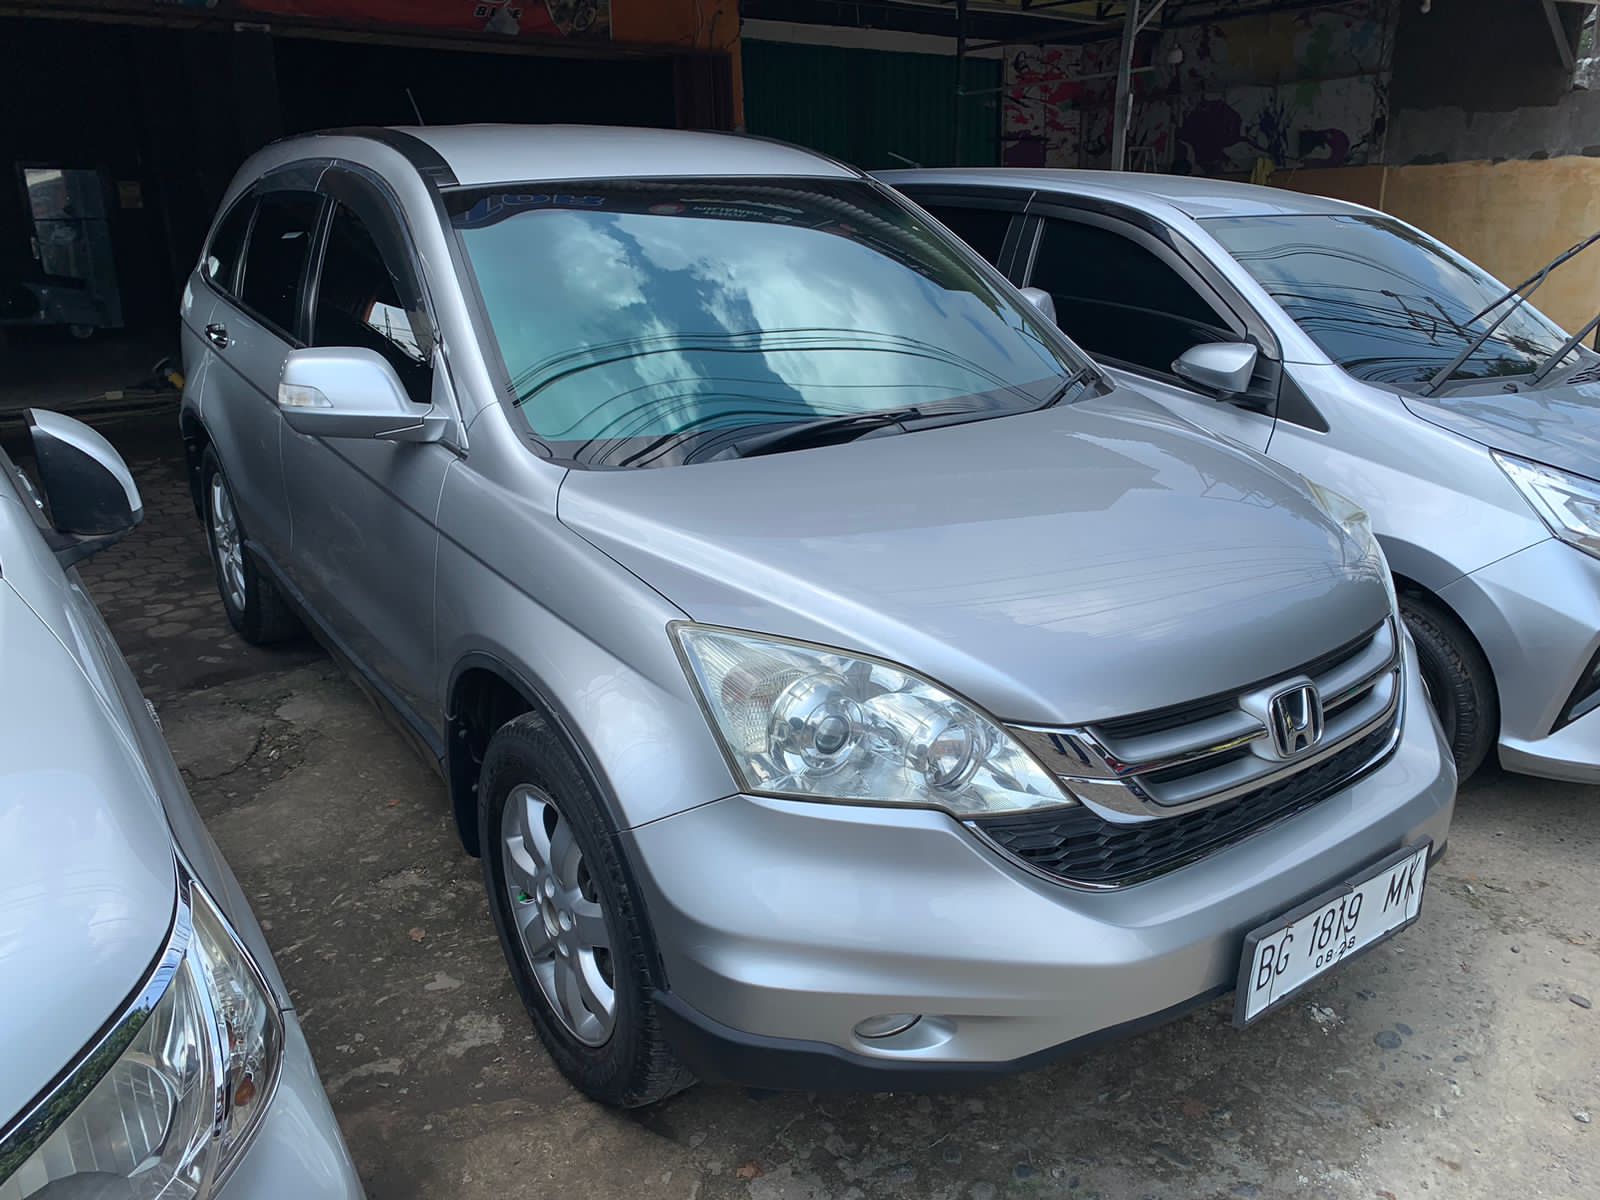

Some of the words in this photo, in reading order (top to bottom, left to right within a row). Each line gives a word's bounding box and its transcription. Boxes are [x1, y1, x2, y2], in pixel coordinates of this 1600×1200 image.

[1256, 934, 1293, 992] BG
[1309, 892, 1363, 957] 1819
[1383, 857, 1421, 913] MK
